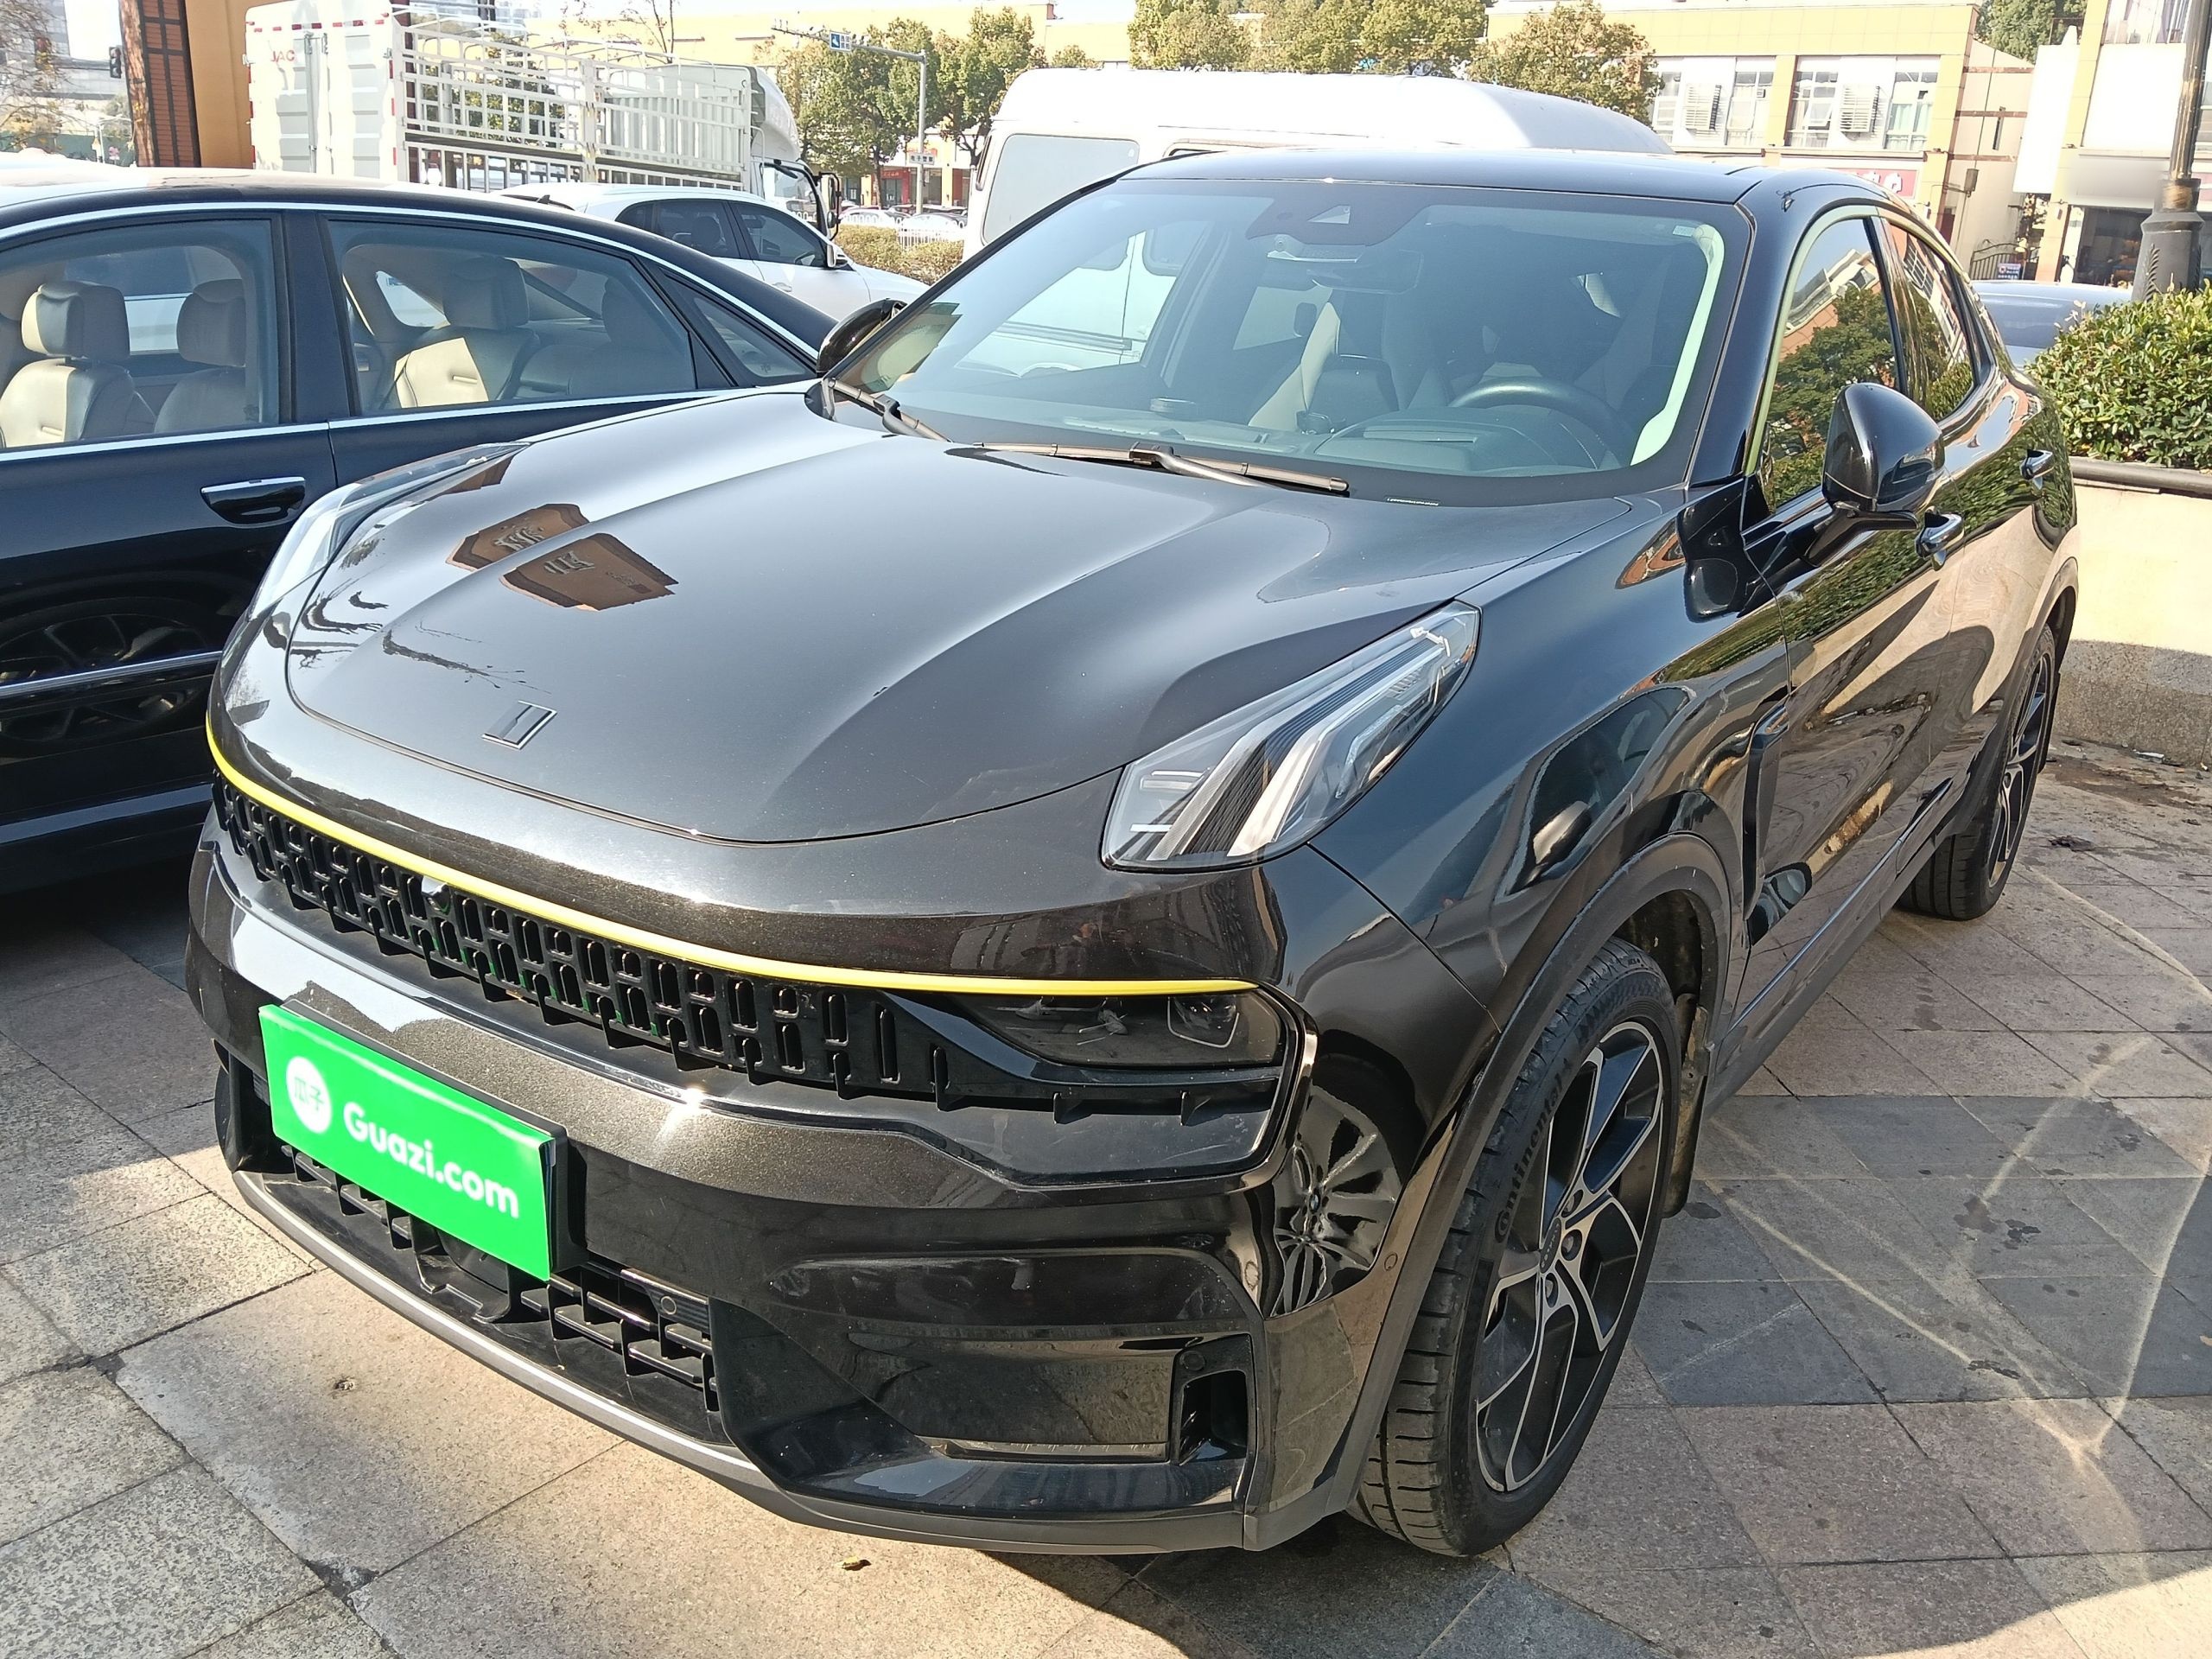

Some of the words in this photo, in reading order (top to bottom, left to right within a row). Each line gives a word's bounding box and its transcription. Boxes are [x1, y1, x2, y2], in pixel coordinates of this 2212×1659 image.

[270, 49, 296, 62] JAC
[294, 1076, 325, 1112] 瓜子
[343, 1102, 520, 1219] Guazi.com
[1495, 1072, 1564, 1243] Continental
